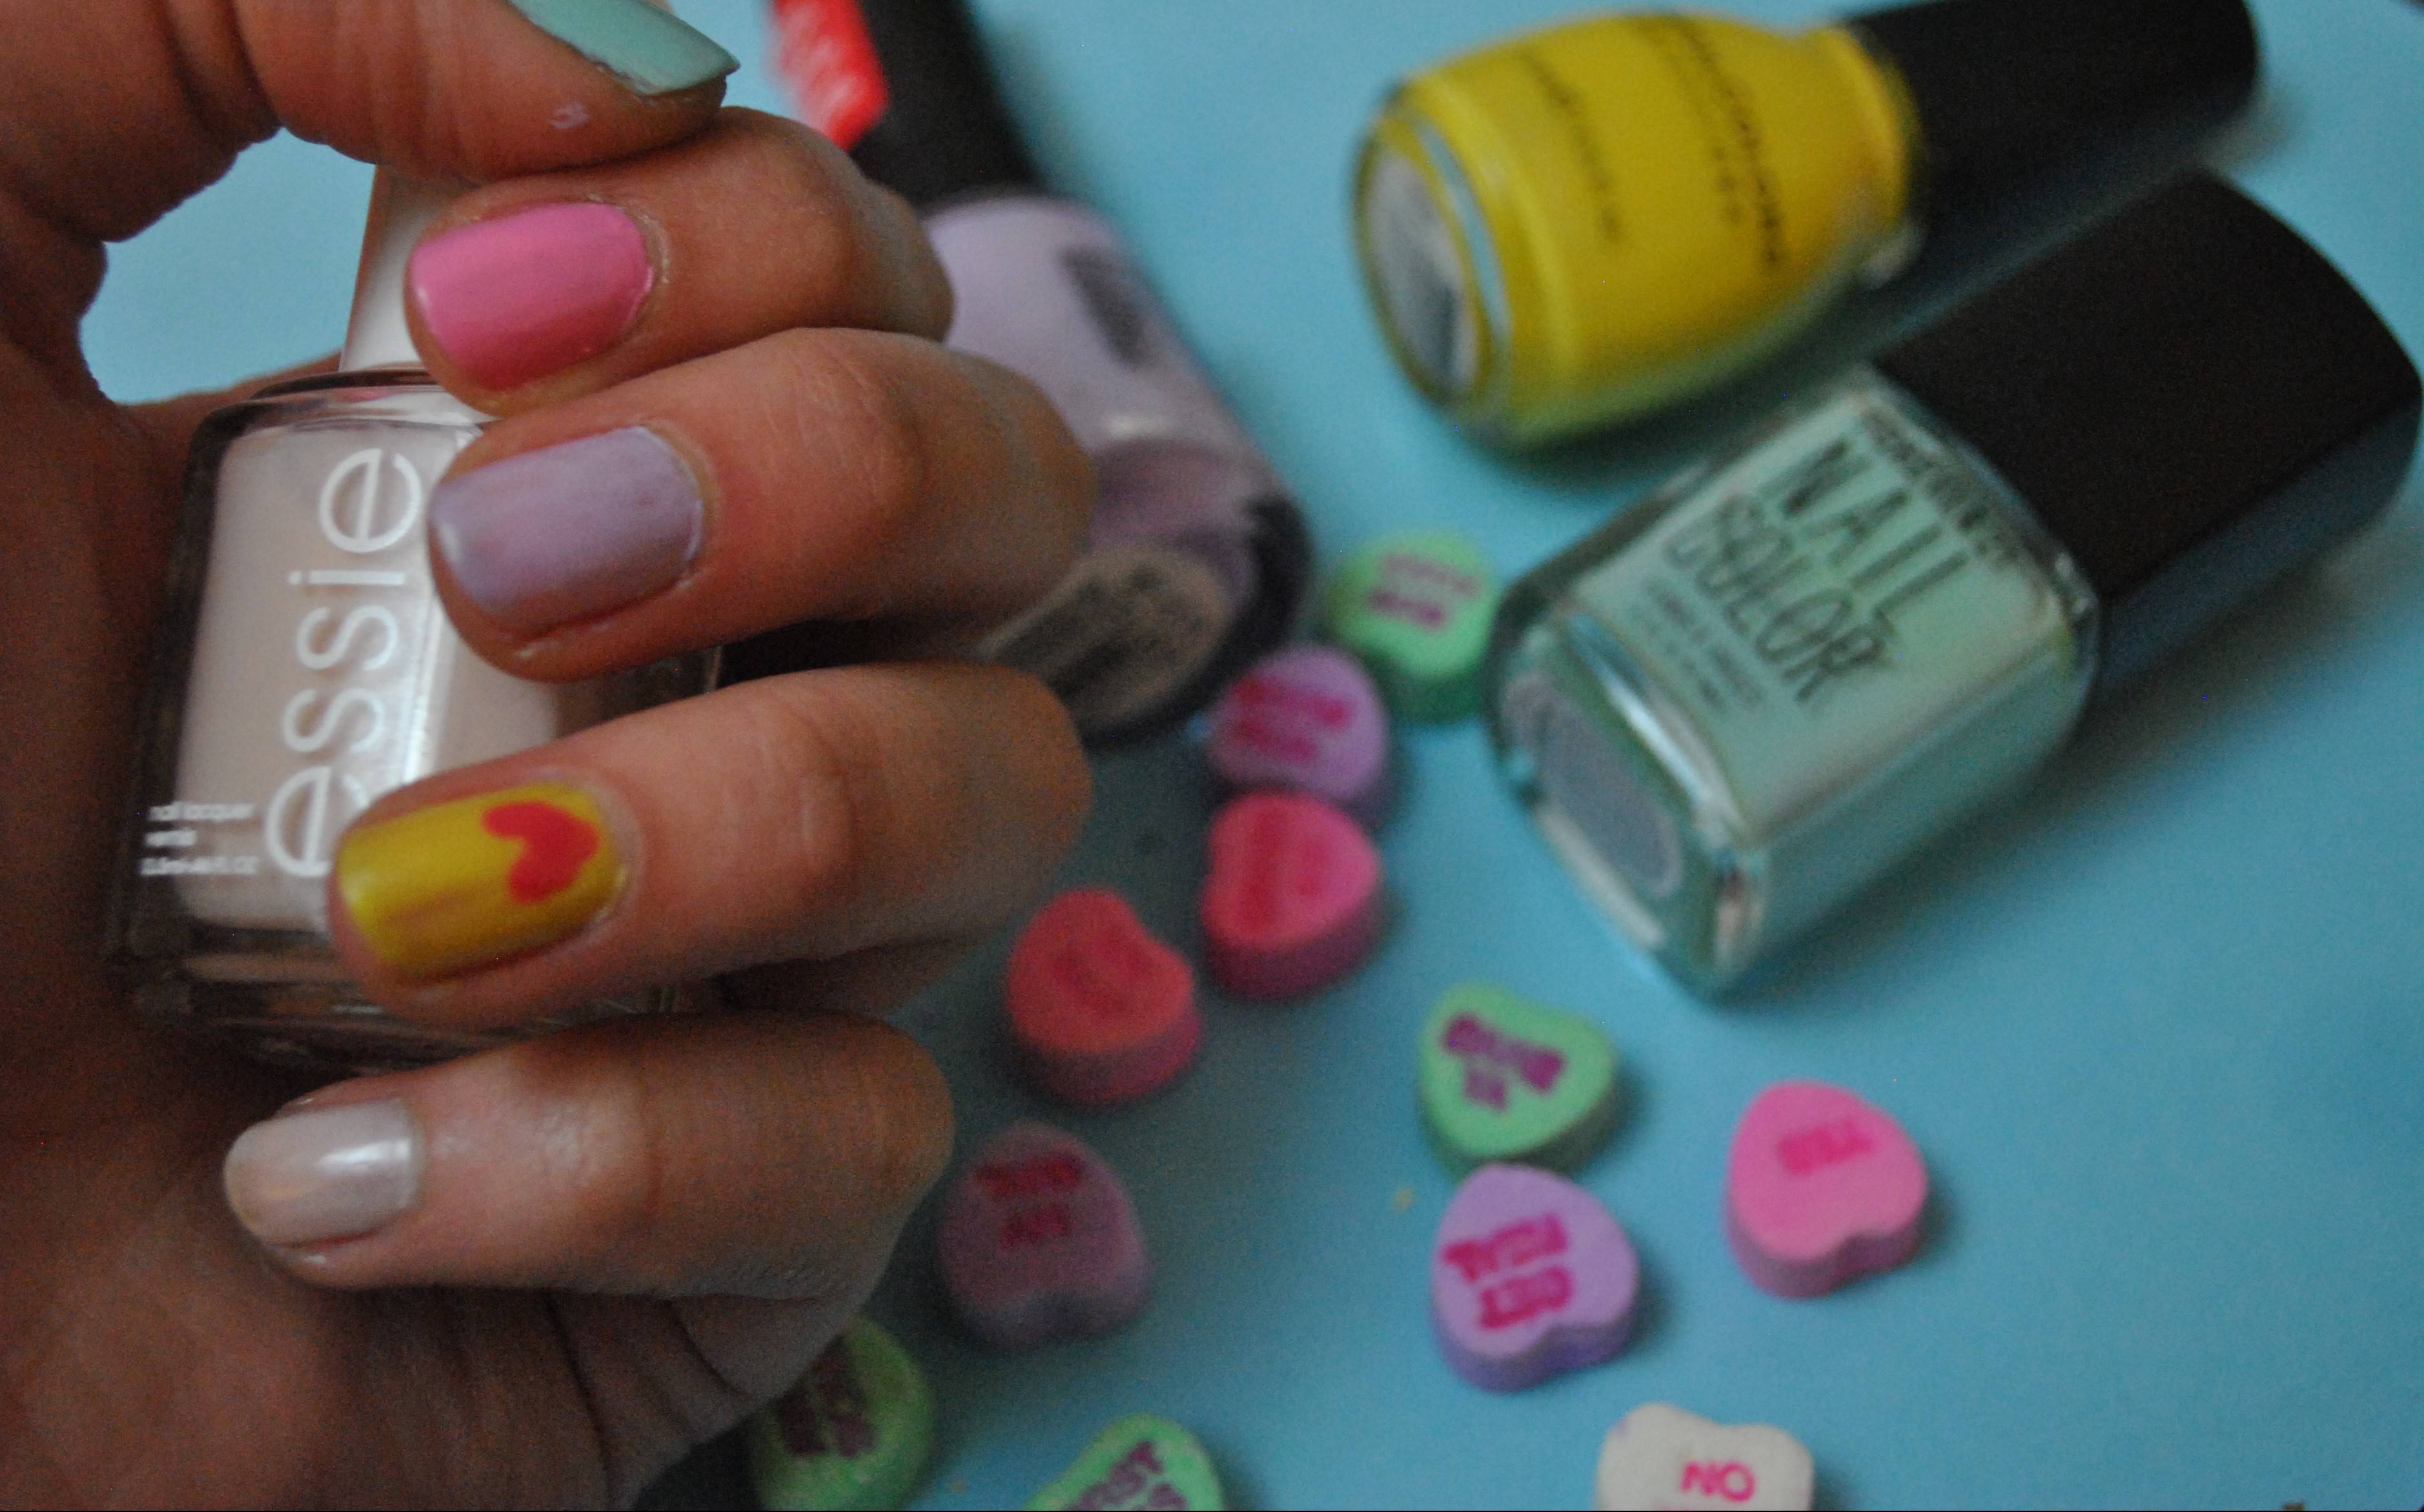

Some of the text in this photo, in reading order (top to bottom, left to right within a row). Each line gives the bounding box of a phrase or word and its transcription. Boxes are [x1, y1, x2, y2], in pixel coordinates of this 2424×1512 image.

[1757, 437, 1971, 632] NAIL
[264, 449, 423, 876] essie
[1682, 1462, 1757, 1502] NO
